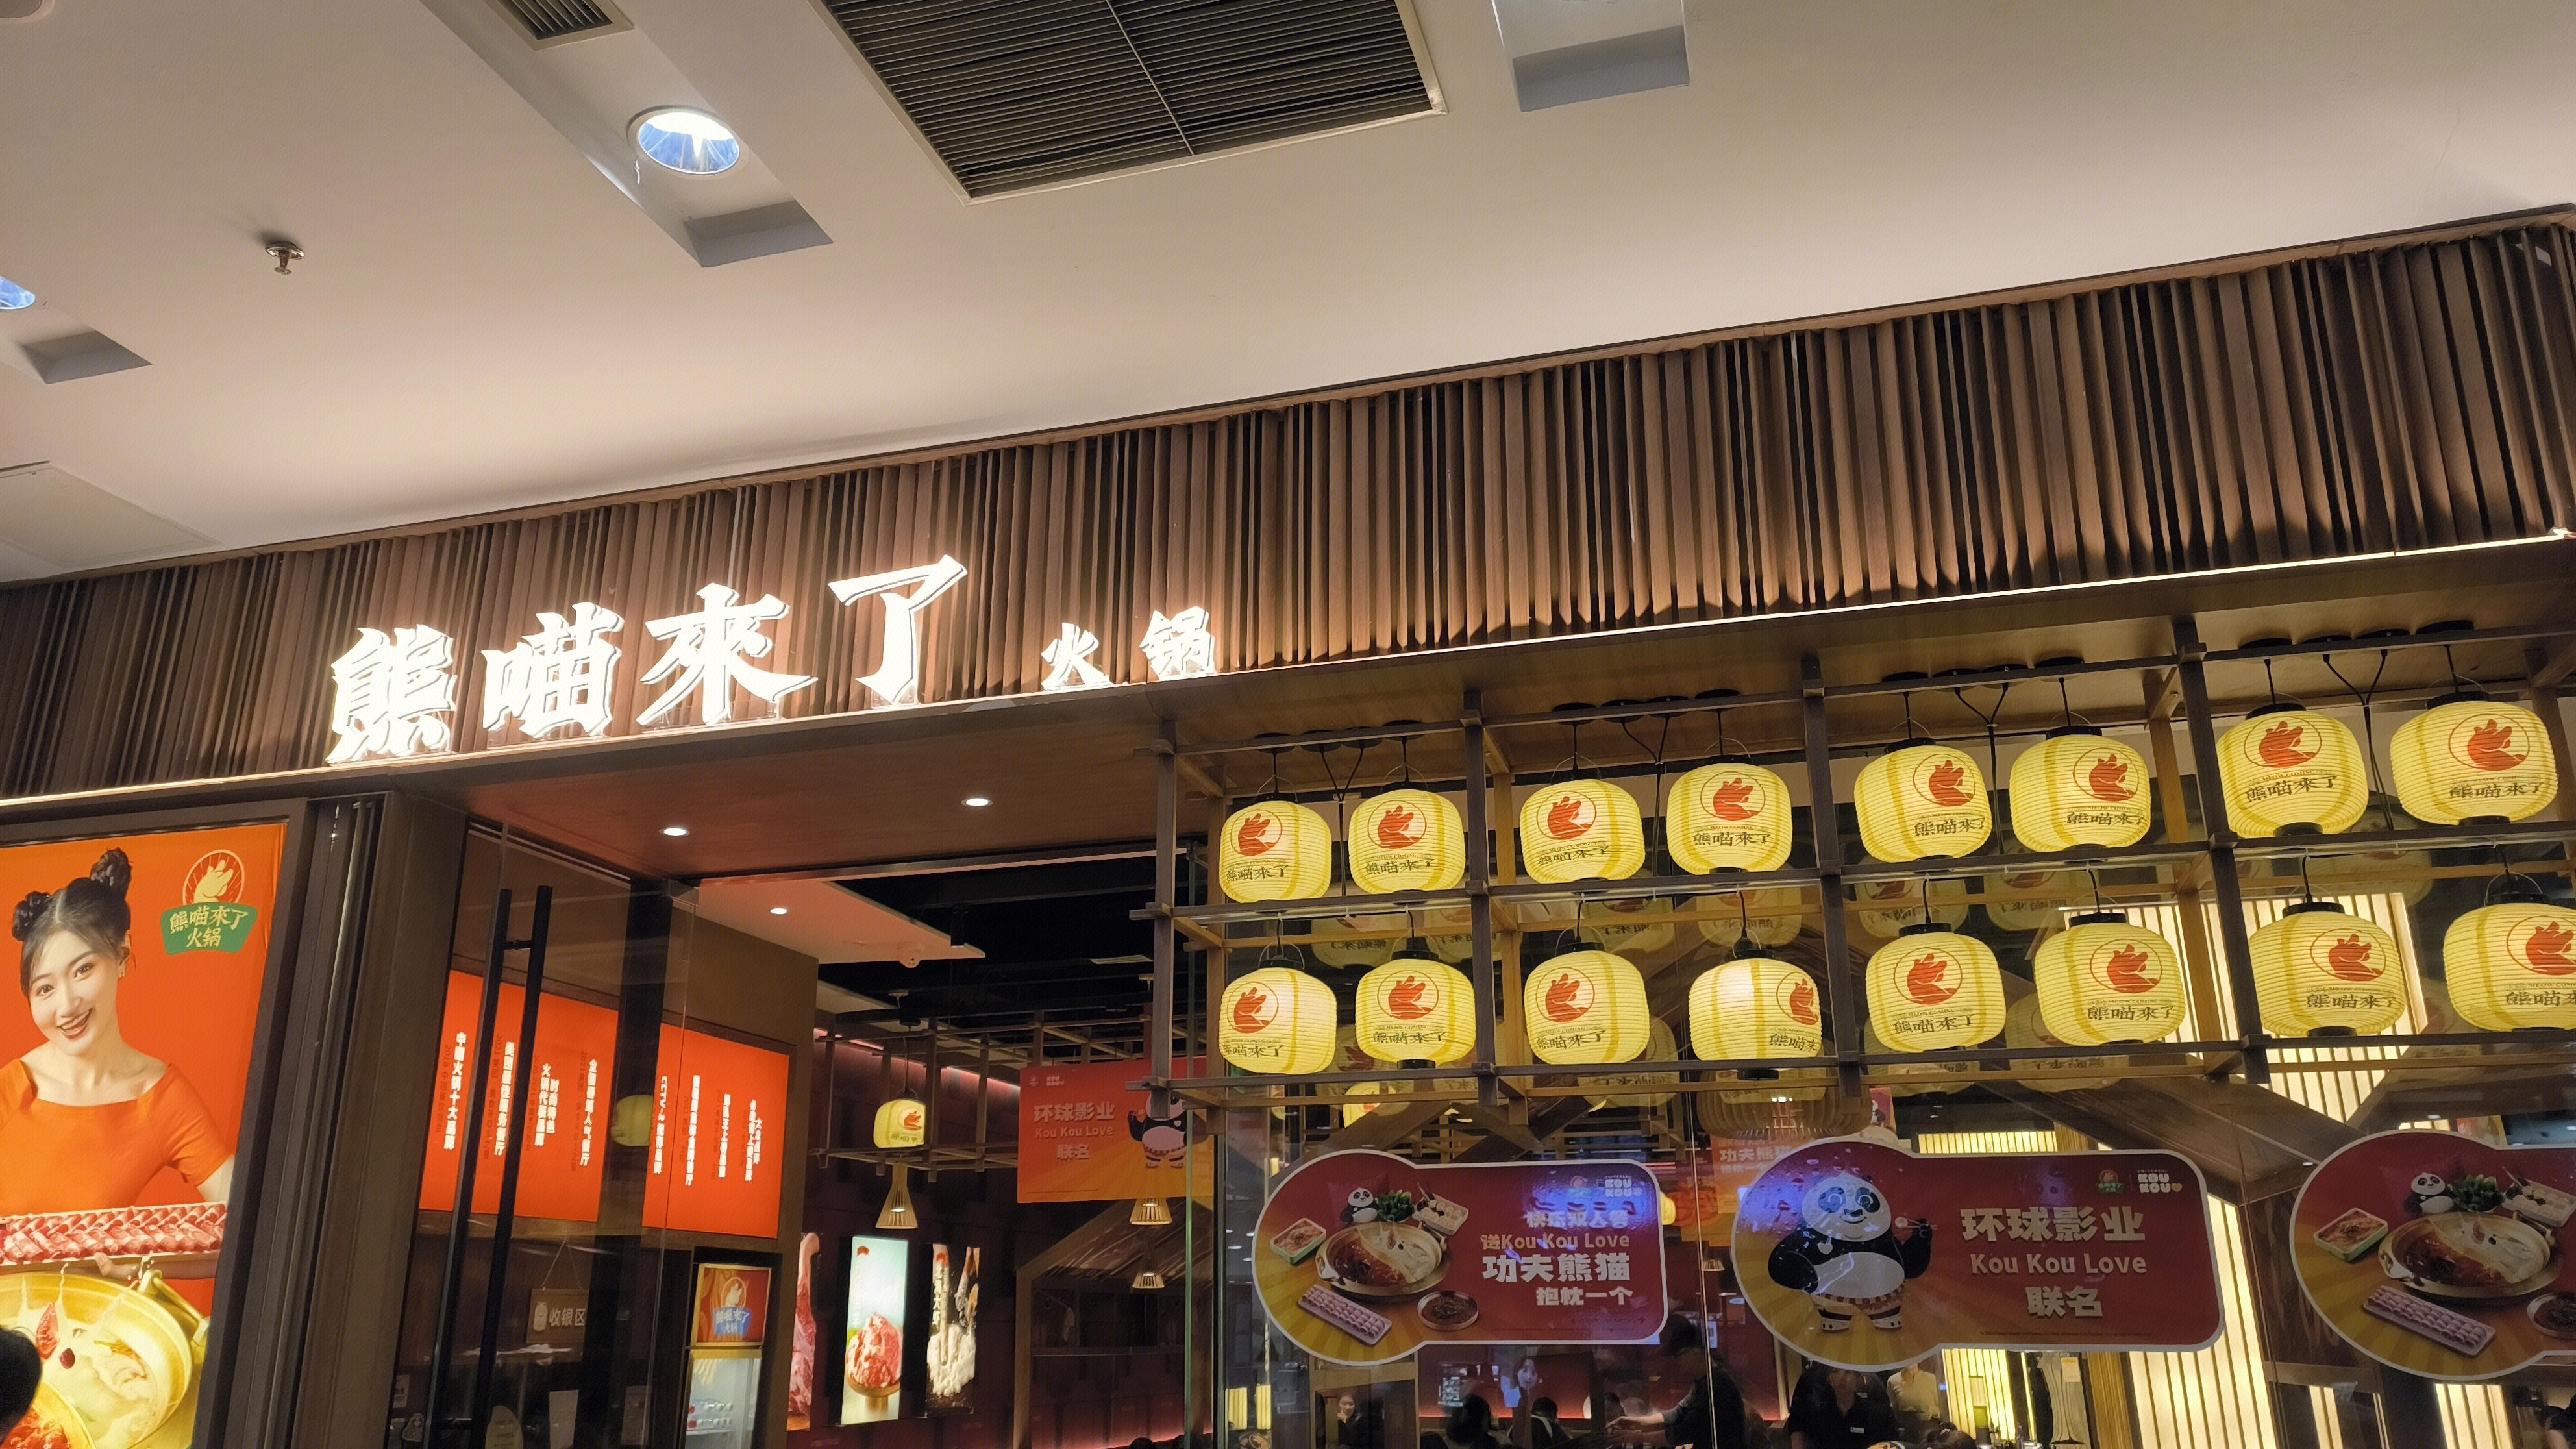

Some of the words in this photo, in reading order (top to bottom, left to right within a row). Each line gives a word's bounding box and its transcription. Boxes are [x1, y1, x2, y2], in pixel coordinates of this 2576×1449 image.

[186, 927, 221, 948] 火锅
[1034, 1102, 1115, 1122] 环球影业
[1035, 1128, 1056, 1139] Kou
[1060, 1127, 1082, 1137] Kou
[1085, 1125, 1114, 1136] Love
[1056, 1144, 1090, 1160] 联名
[2138, 1173, 2170, 1183] KOU
[2139, 1183, 2171, 1193] KOU
[1960, 1206, 2146, 1241] 环球影业
[1542, 1233, 1578, 1249] Kou
[1585, 1233, 1630, 1249] Love
[1482, 1252, 1630, 1283] 功夫熊猫
[1970, 1253, 2019, 1274] Kou
[2026, 1253, 2076, 1274] Kou
[2083, 1253, 2147, 1274] Love
[1536, 1286, 1633, 1306] 抱枕一个
[2025, 1285, 2103, 1317] 联名
[549, 1307, 587, 1327] 收银区
